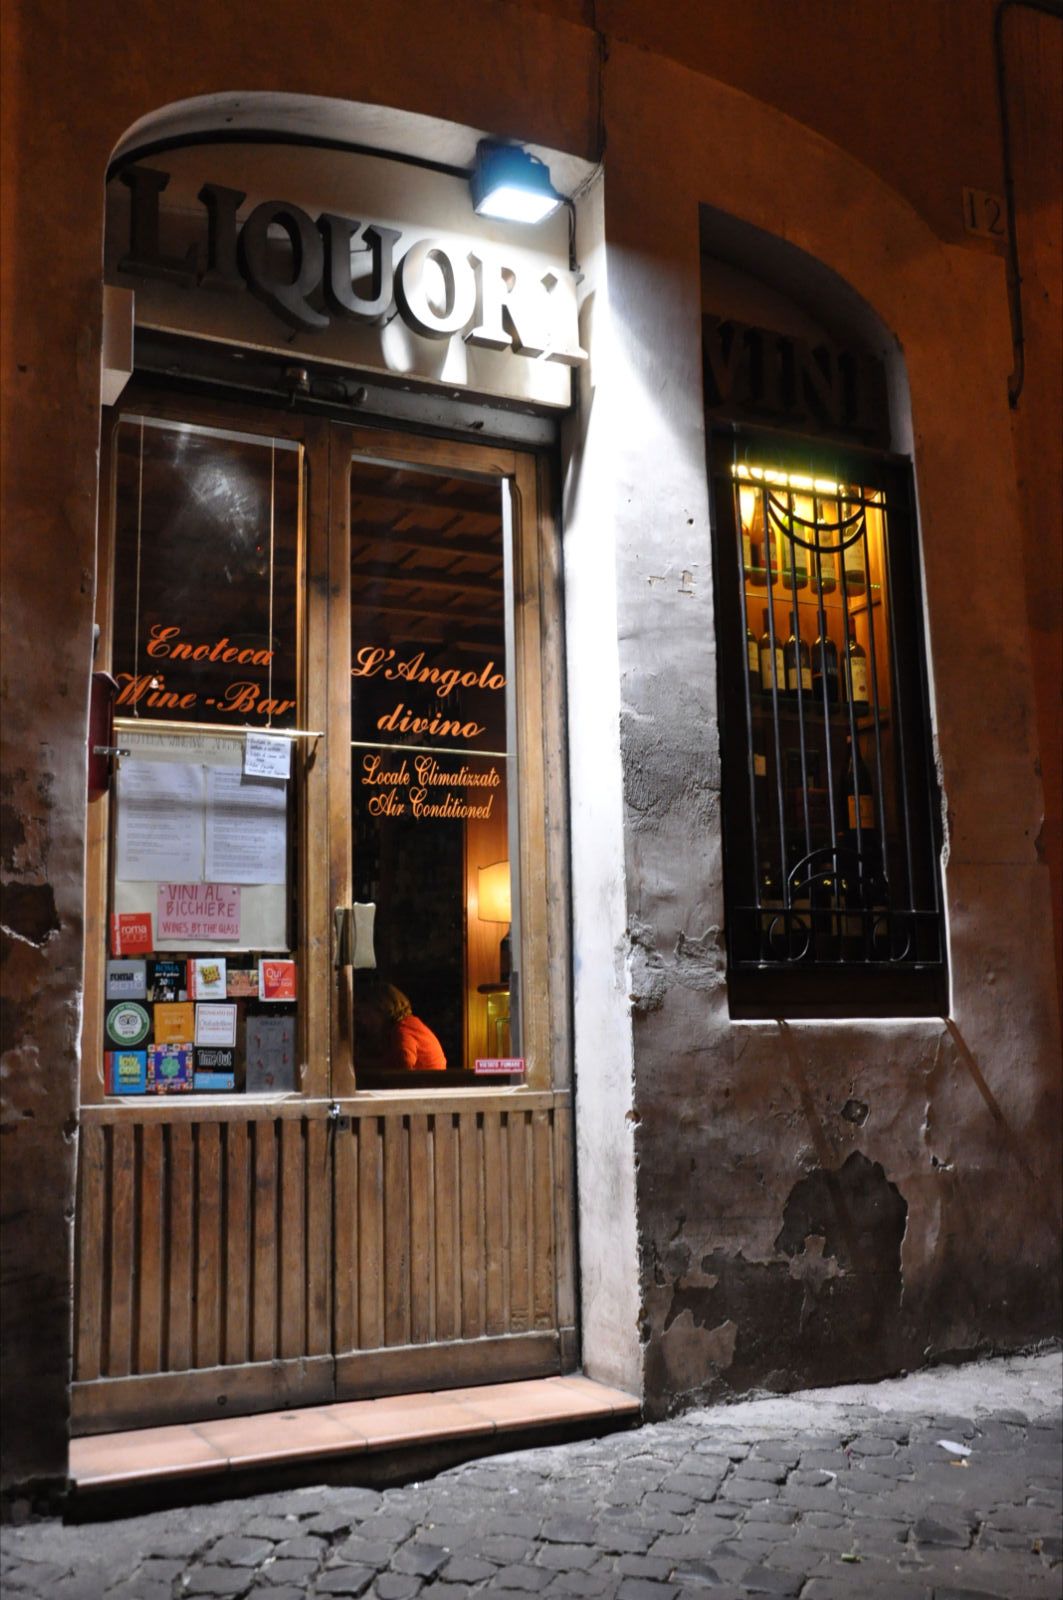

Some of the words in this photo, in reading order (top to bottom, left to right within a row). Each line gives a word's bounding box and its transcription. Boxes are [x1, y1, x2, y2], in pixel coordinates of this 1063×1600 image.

[966, 191, 1005, 236] 12
[117, 166, 588, 365] LIQUORI
[702, 313, 867, 429] VINI
[147, 624, 275, 666] Enoteca
[351, 646, 508, 697] L'Angolo
[115, 672, 197, 710] Wine
[377, 703, 487, 738] divino
[361, 754, 410, 785] Locale
[414, 755, 501, 787] Climatizzato
[368, 787, 405, 816] Air
[409, 786, 494, 820] Conditioned
[166, 901, 235, 917] BICCHIERE
[168, 885, 198, 900] VINI
[205, 885, 223, 901] AL
[121, 925, 147, 935] roma
[162, 922, 188, 933] WINES
[191, 922, 201, 932] BY
[202, 923, 217, 933] THE
[218, 923, 239, 934] GLASS
[266, 968, 282, 980] Qui
[197, 1050, 216, 1067] Time
[217, 1050, 232, 1067] Out
